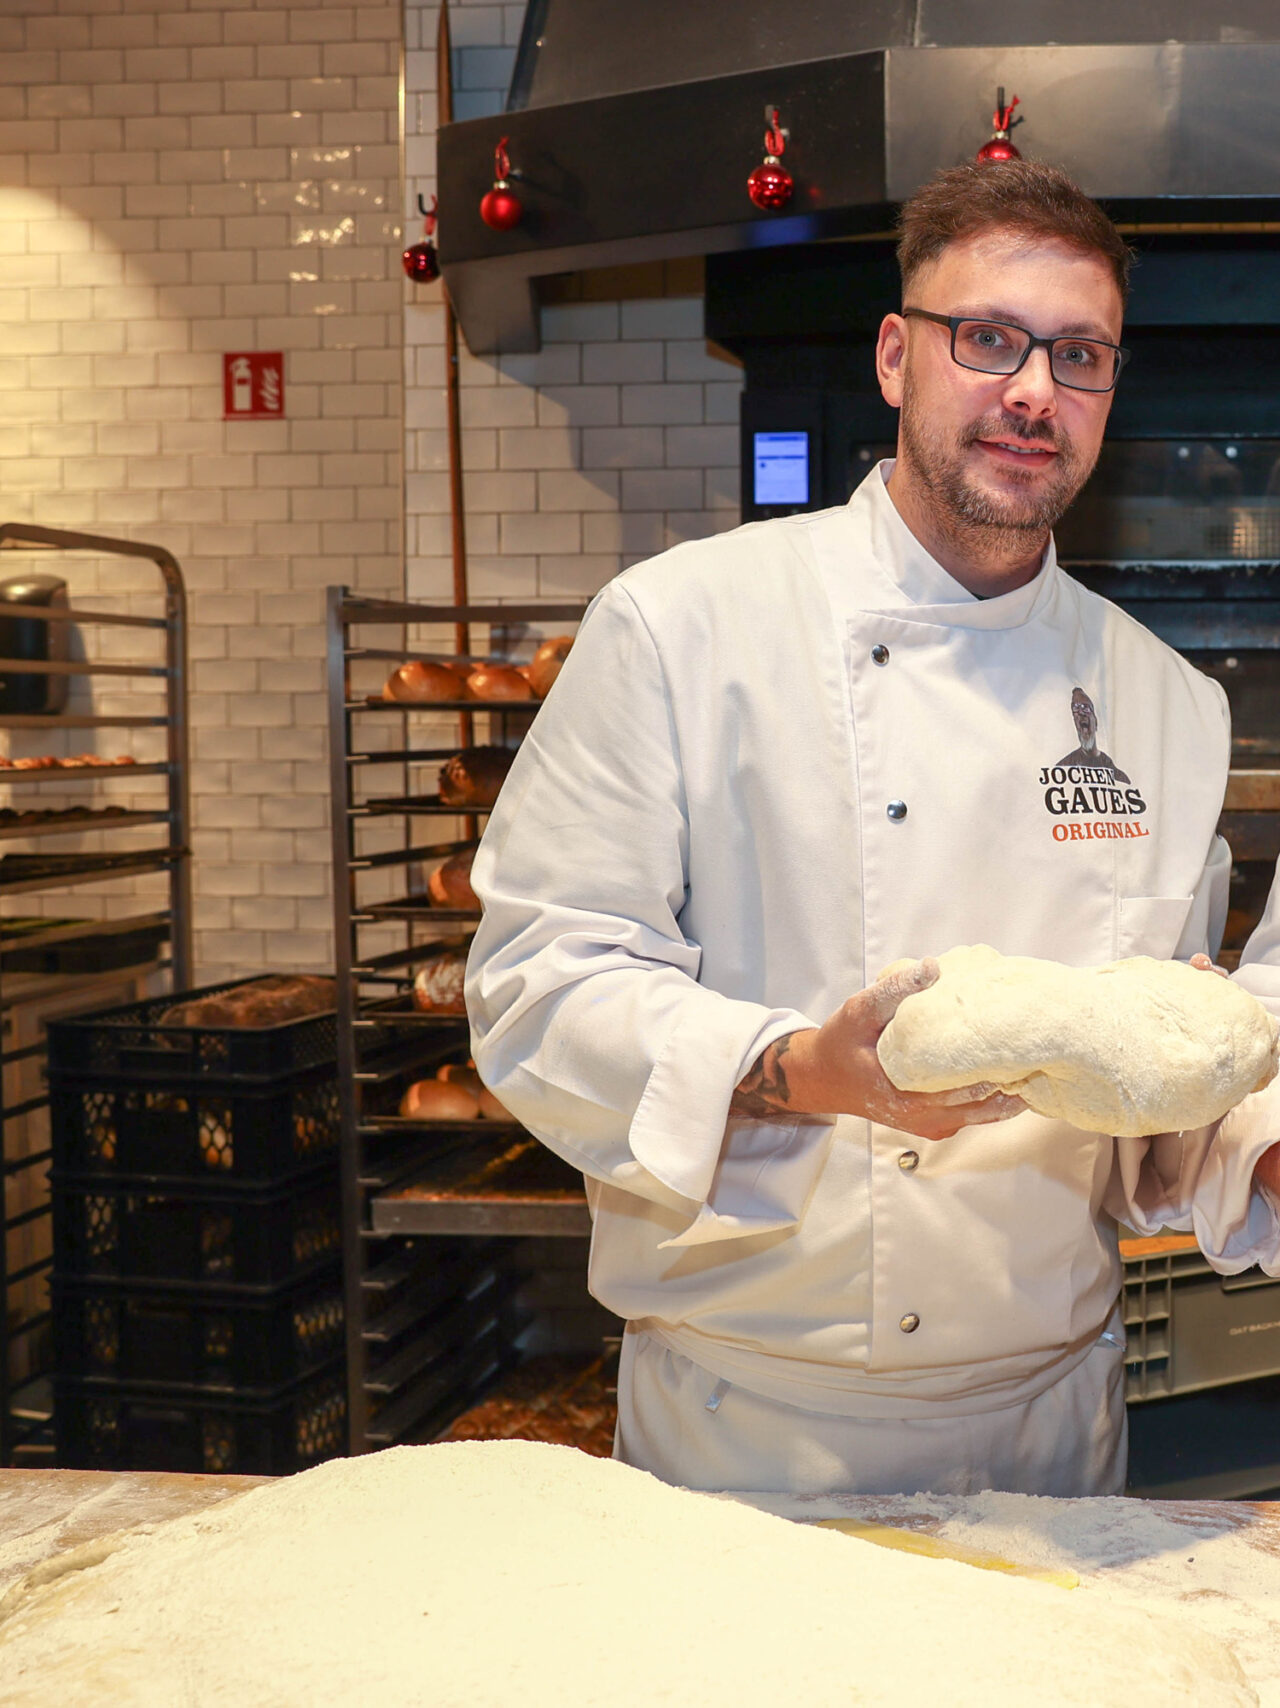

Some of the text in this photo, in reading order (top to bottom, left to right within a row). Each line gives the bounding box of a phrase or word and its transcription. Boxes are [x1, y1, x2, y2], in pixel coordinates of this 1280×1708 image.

[1039, 766, 1116, 786] JOCHEN
[1044, 786, 1147, 815] GAUES
[1052, 821, 1150, 842] ORIGINAL
